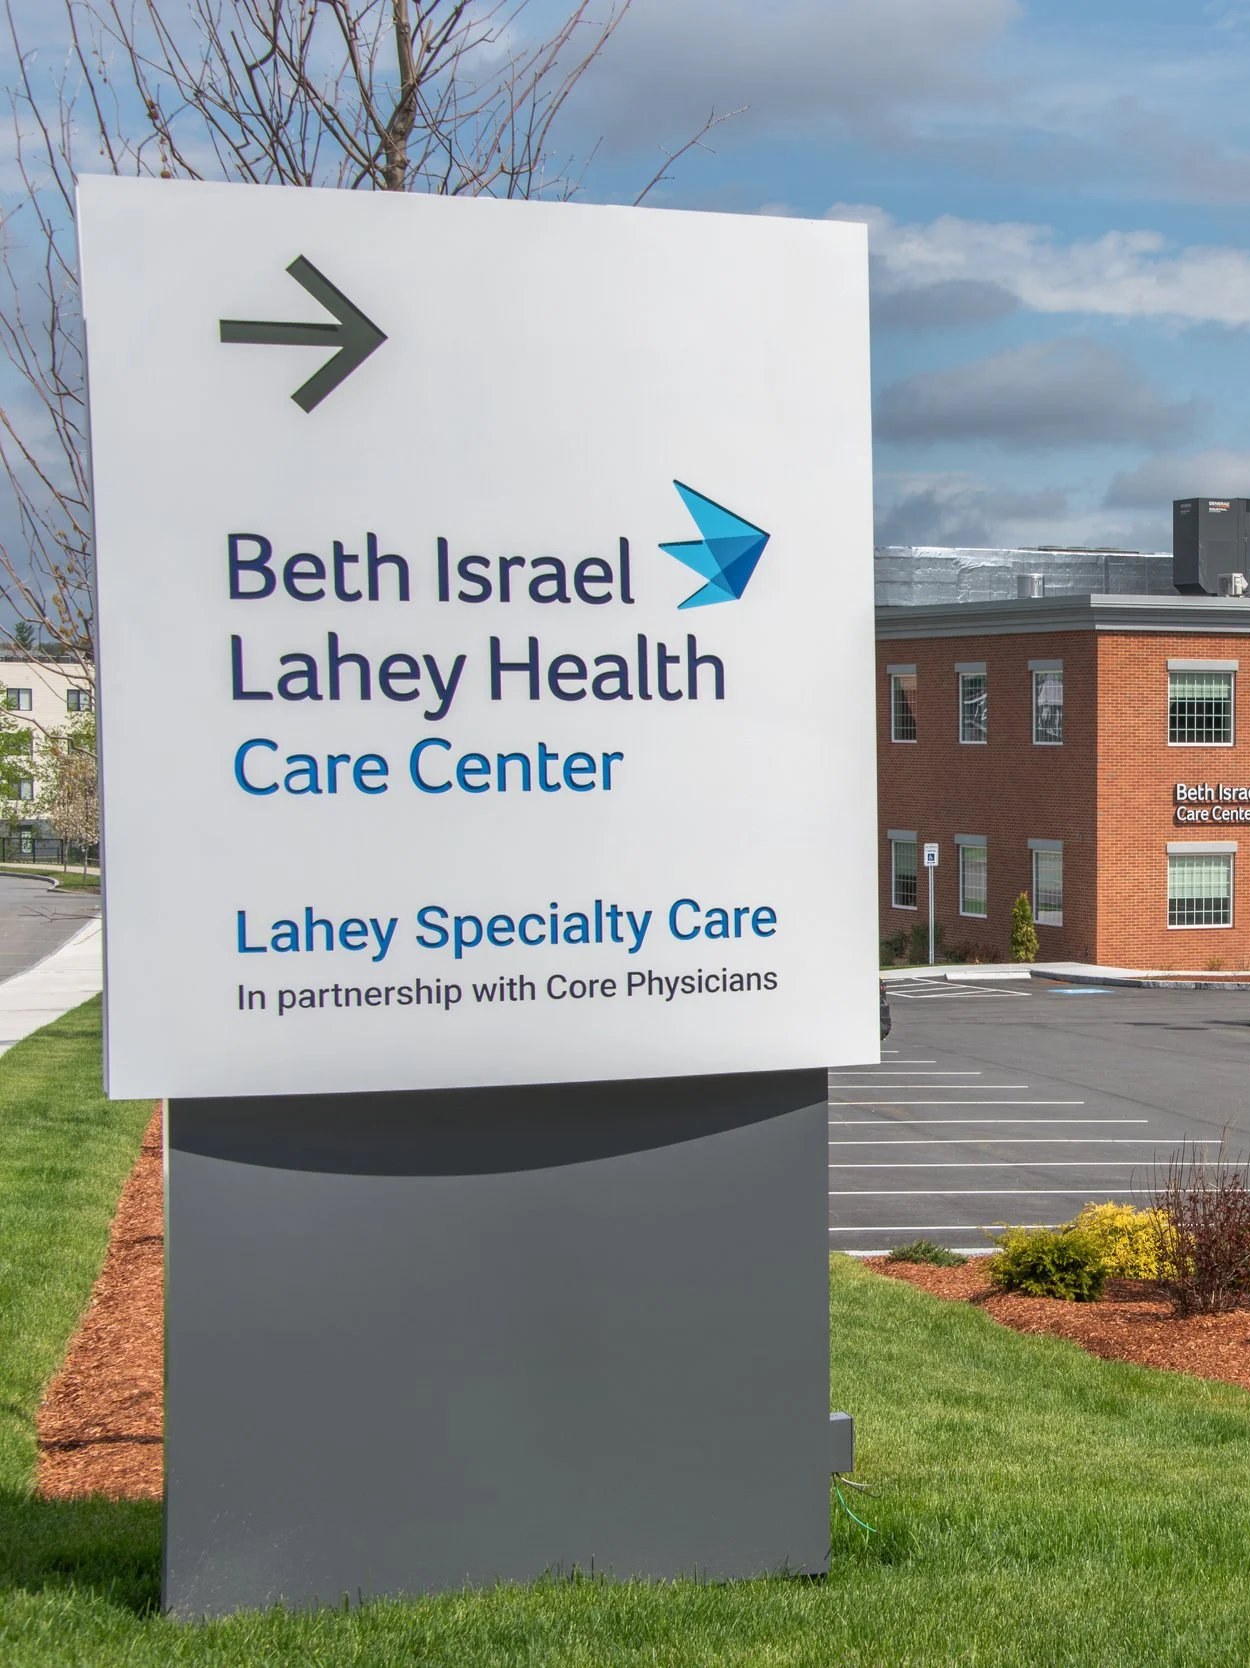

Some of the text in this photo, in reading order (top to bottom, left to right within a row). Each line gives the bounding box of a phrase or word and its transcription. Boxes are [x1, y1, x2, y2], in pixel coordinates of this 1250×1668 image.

[228, 532, 635, 605] Beth Israel
[230, 631, 725, 722] Lahey Health
[234, 737, 624, 796] Care Center
[1176, 782, 1215, 801] Beth
[1176, 805, 1209, 821] Care
[236, 898, 778, 963] Lahey Specialty Care
[237, 966, 778, 1017] In partnership with Core Physicians
